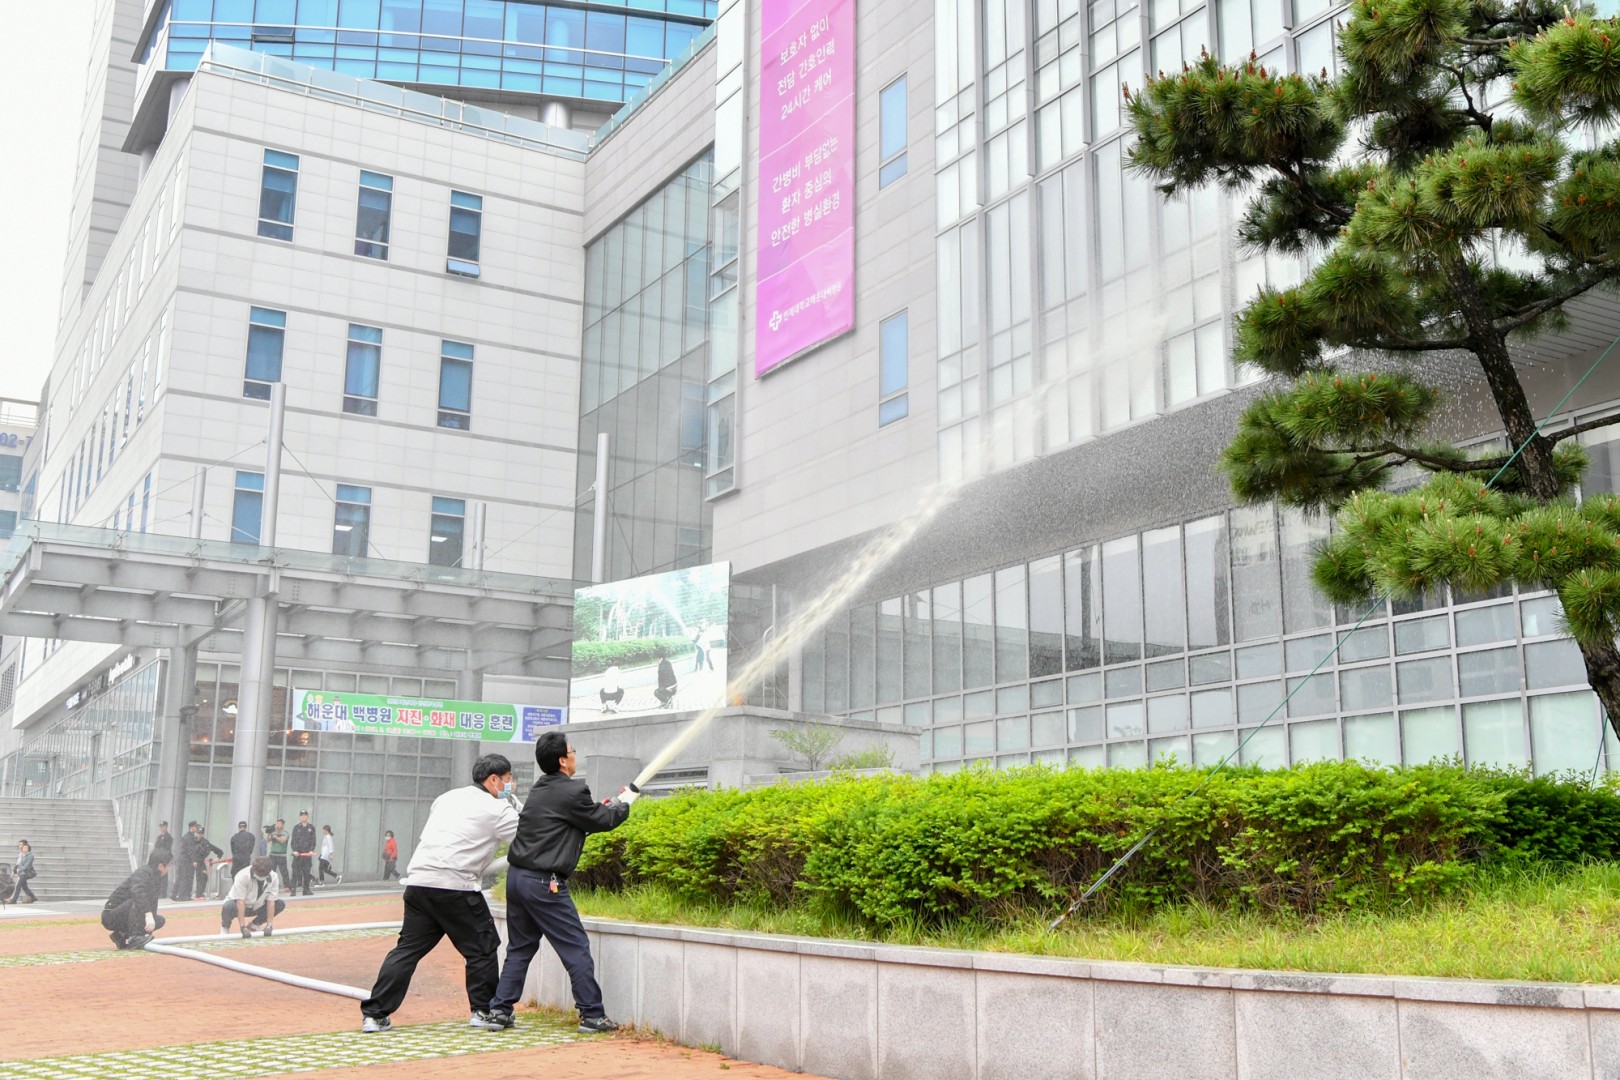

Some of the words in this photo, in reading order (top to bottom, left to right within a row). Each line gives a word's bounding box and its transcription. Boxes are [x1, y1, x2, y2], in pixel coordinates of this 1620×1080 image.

[780, 31, 807, 66] 보호자
[810, 13, 829, 41] 없이
[777, 69, 795, 96] 전담
[798, 37, 835, 79] 간호인력
[781, 84, 811, 120] 24시간
[814, 68, 832, 93] 케어
[772, 160, 800, 193] 간병비
[804, 137, 838, 170] 부담없는
[781, 189, 801, 214] 환자
[804, 167, 832, 199] 중심의
[771, 216, 800, 247] 안전한
[804, 190, 840, 227] 병실환경
[307, 703, 348, 721] 해운대
[353, 706, 392, 723] 백병원
[460, 712, 484, 730] 대응
[489, 714, 513, 731] 훈련
